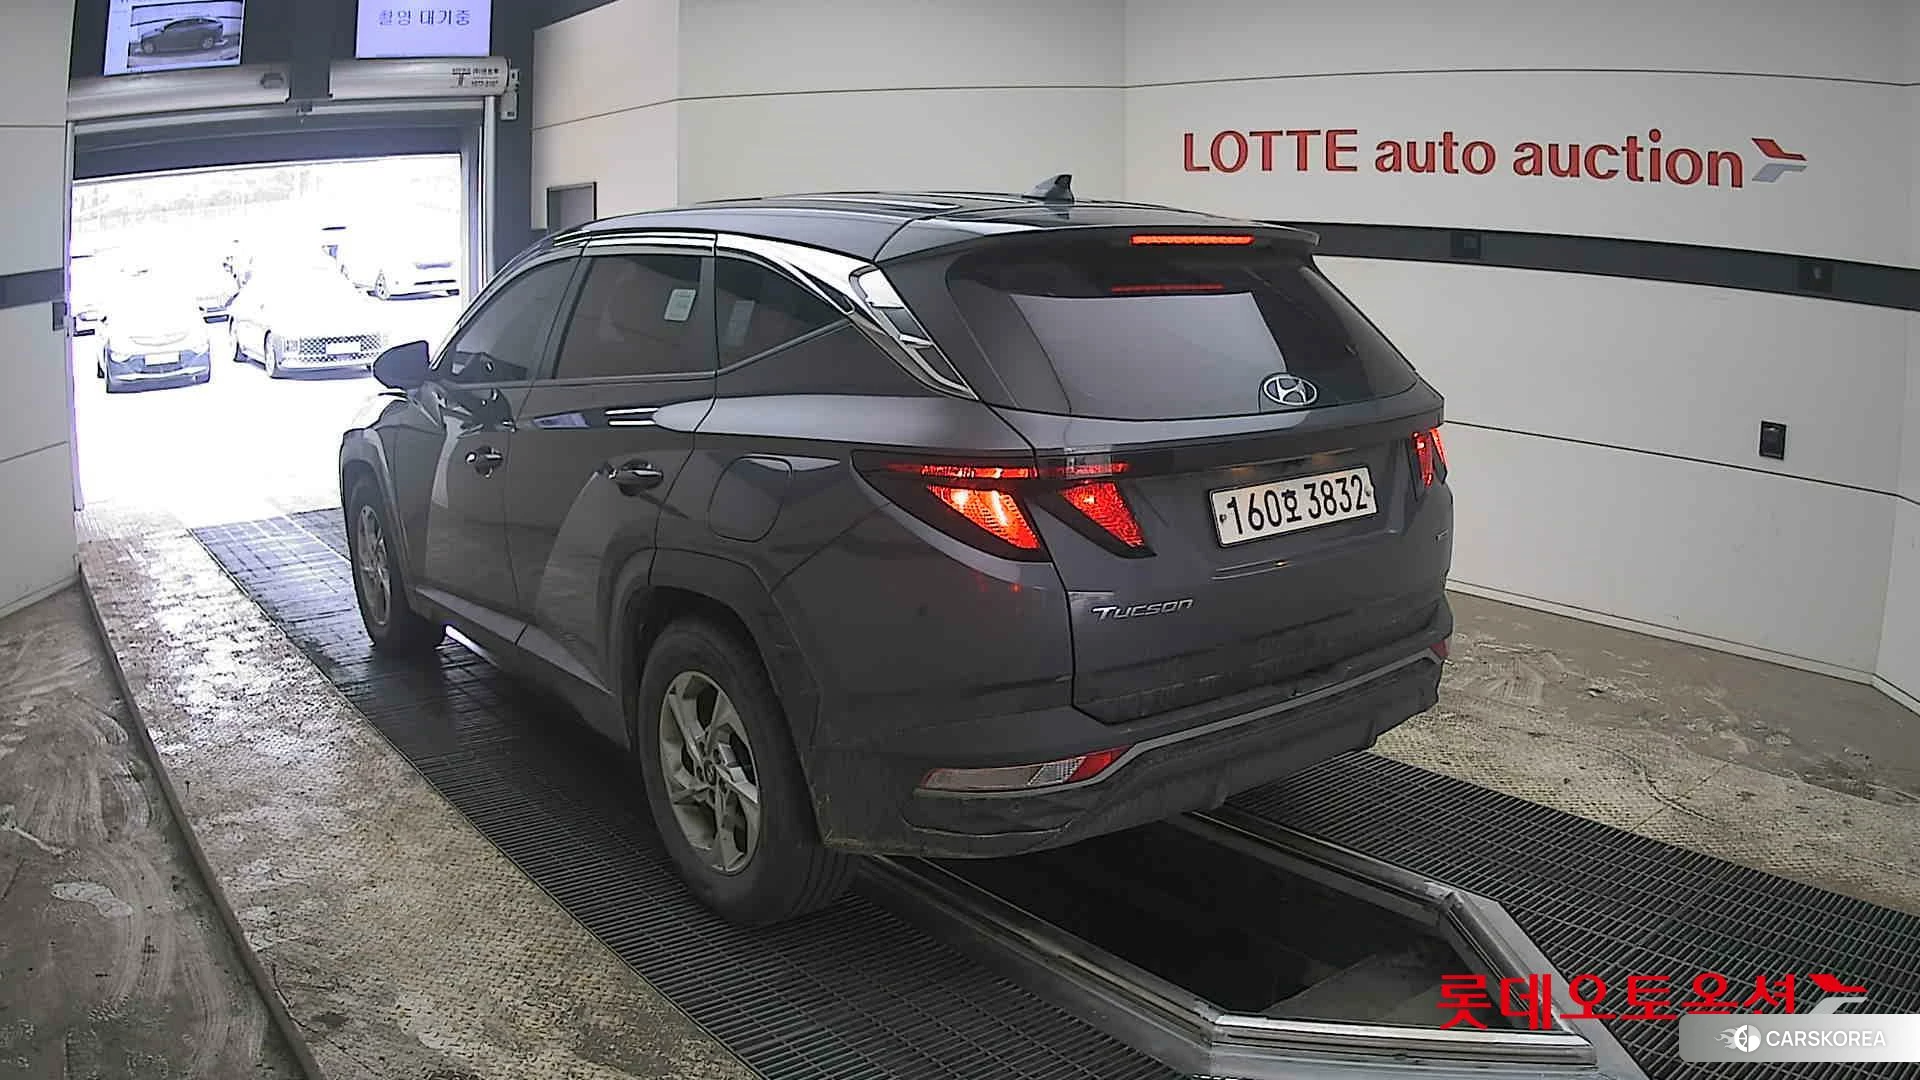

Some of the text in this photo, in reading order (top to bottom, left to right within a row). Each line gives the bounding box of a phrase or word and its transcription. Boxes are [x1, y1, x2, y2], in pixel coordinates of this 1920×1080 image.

[420, 9, 471, 26] 대기중
[1184, 128, 1743, 189] LOTTE auto auction
